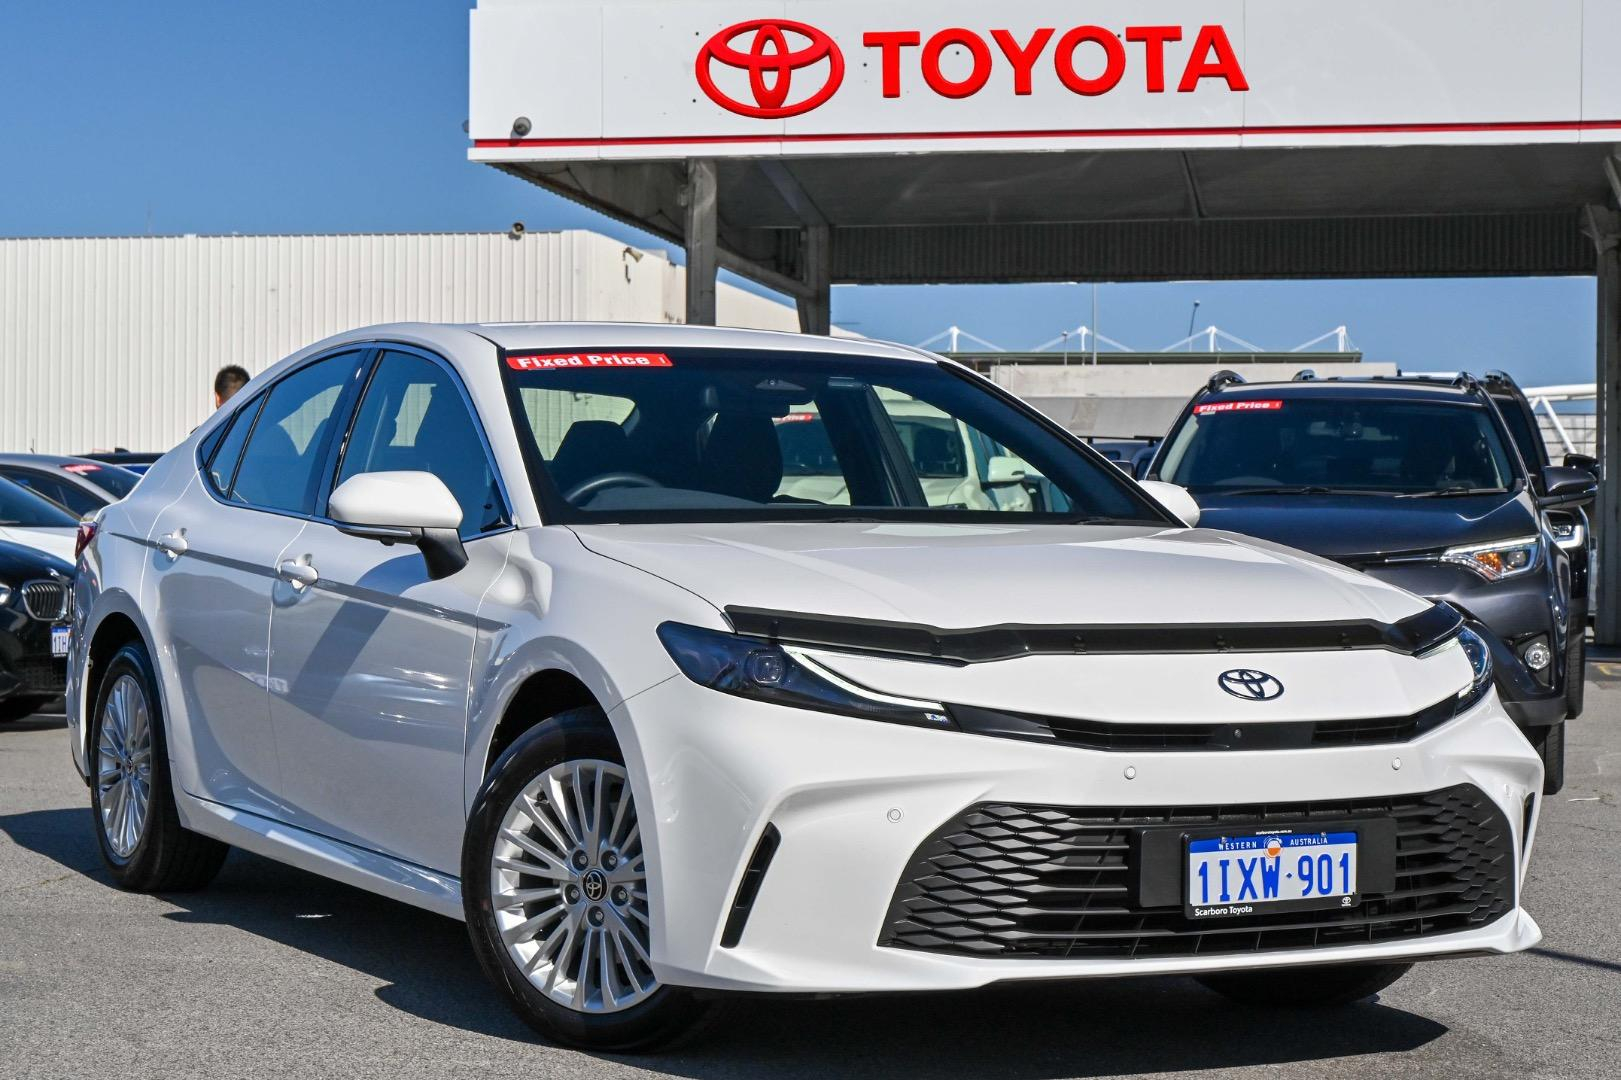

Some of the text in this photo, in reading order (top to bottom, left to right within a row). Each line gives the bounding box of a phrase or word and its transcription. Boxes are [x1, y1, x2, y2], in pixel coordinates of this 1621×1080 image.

[863, 25, 1249, 99] TOYOTA
[516, 355, 584, 368] Fixed
[587, 354, 650, 366] Price
[1200, 401, 1270, 412] Fixed Price
[1218, 837, 1328, 851] WESTERN AUSTRALIA
[1195, 905, 1253, 917] Scarboro Toyota
